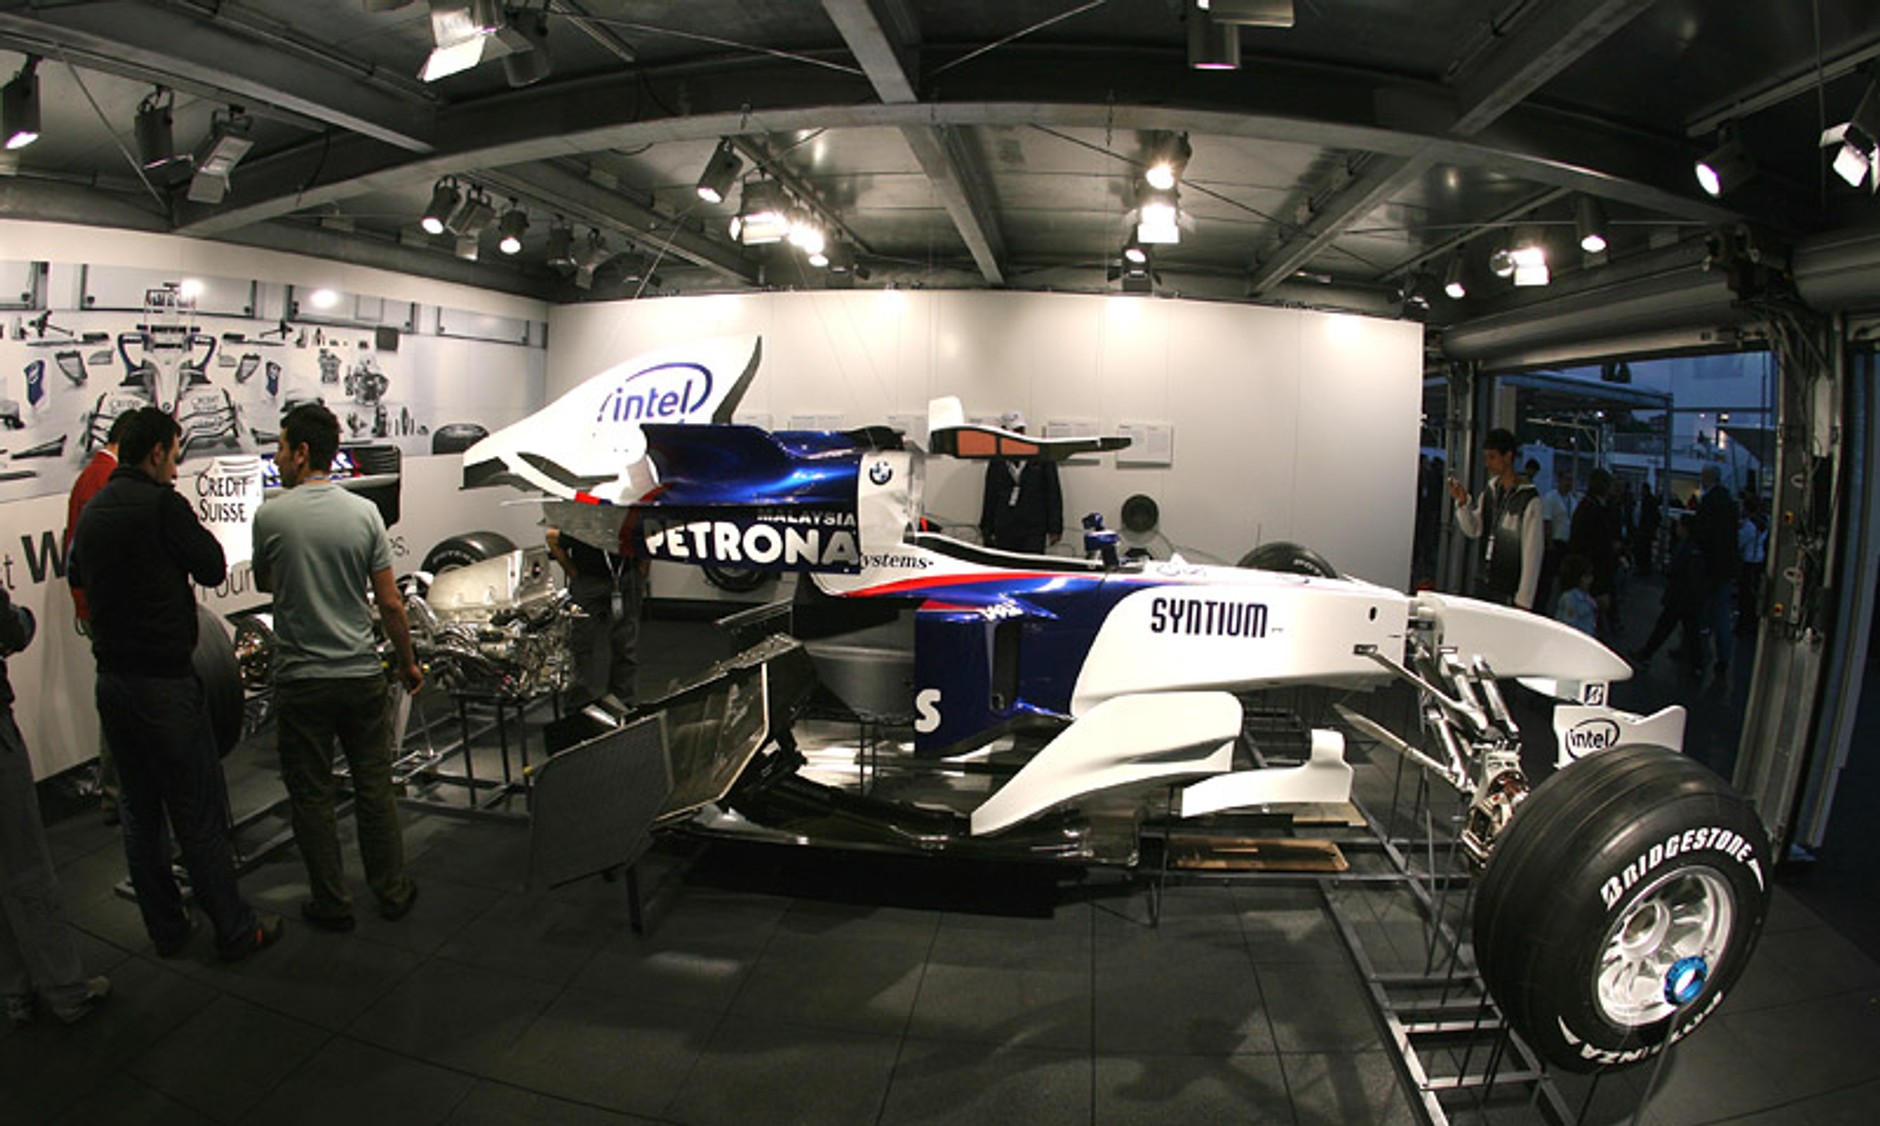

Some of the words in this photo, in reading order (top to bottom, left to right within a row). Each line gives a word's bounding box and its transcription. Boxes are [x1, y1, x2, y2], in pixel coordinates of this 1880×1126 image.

[612, 379, 692, 422] intel
[199, 498, 247, 523] SUISSE
[757, 507, 856, 527] MALAYSIA
[643, 519, 860, 565] PETRONA
[1151, 597, 1268, 638] SYNTIUM
[914, 688, 942, 732] S
[1570, 728, 1610, 749] intel
[1600, 827, 1752, 911] BRIDGESTONE
